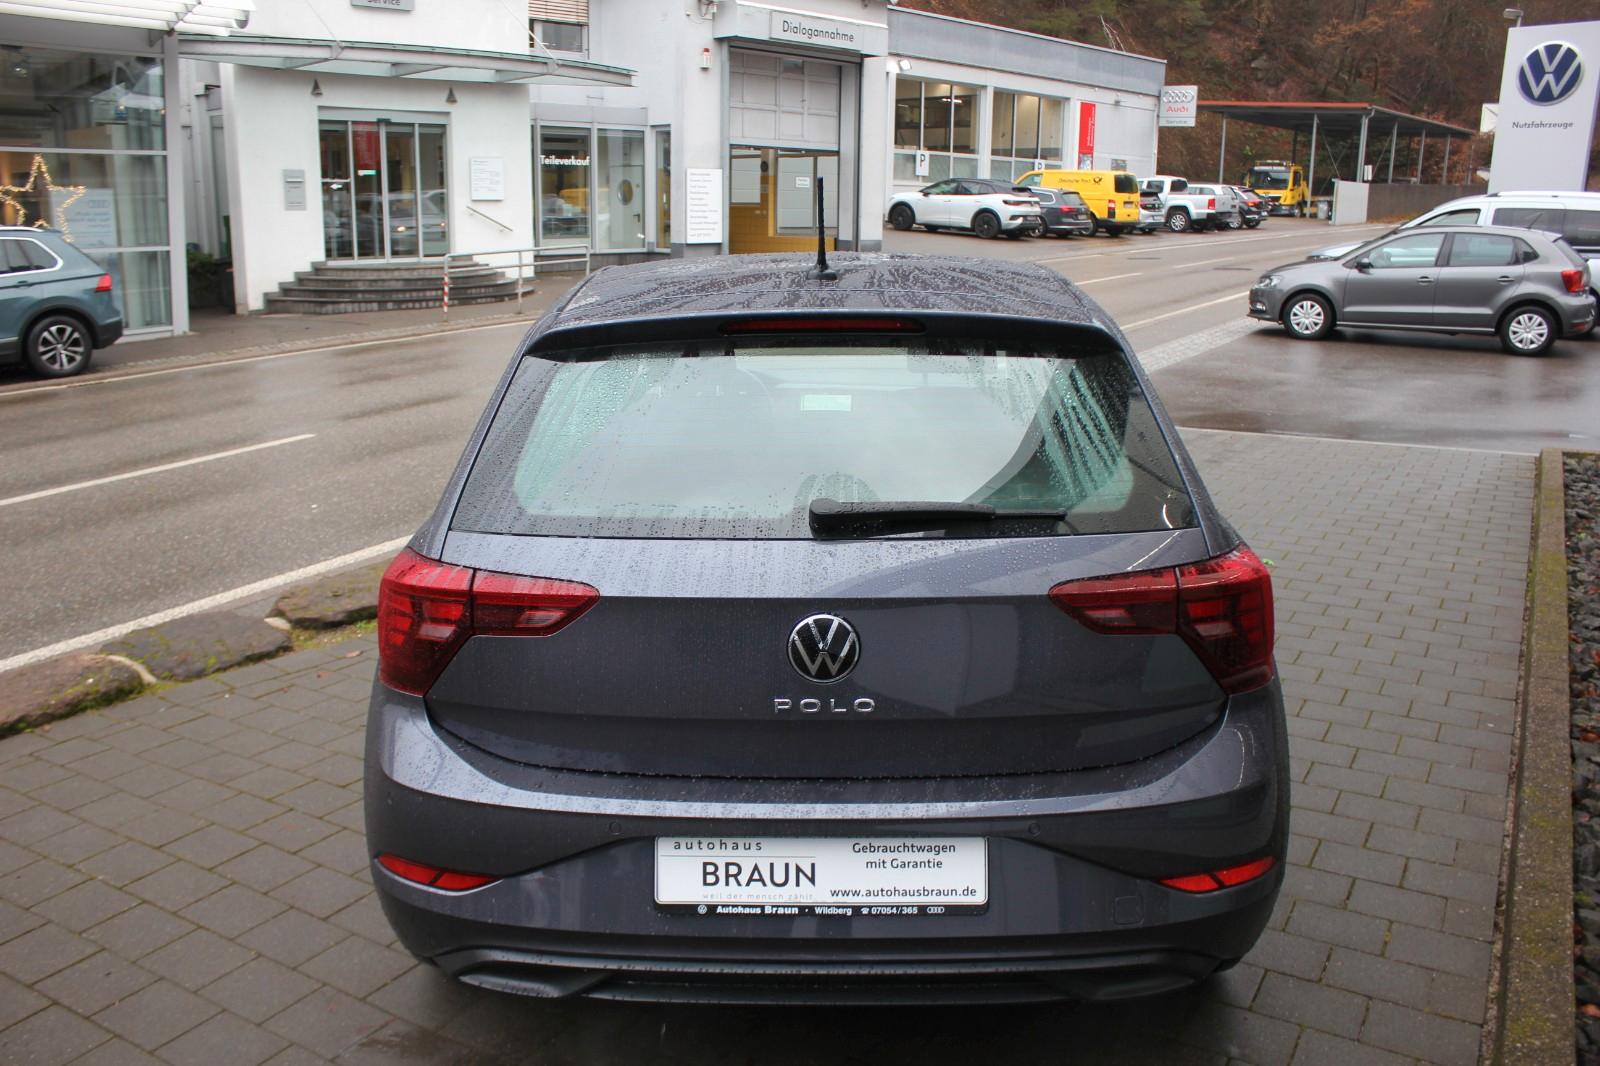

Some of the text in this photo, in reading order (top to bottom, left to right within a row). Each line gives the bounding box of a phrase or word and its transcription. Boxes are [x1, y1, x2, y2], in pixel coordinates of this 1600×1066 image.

[782, 20, 855, 42] Dialogannahme
[1512, 121, 1574, 129] Nutzfahrzeuge
[538, 154, 591, 166] Teileverkauf
[919, 153, 926, 167] P
[773, 698, 875, 712] POLO
[673, 839, 763, 851] autohaus
[852, 842, 956, 855] Gebrauchtwagen
[866, 858, 943, 869] mit Garantie
[702, 862, 816, 888] BRAUN
[830, 886, 977, 898] www.autohausbraun.de
[716, 906, 918, 916] Autohaus Braun Wildberg 07054/365
